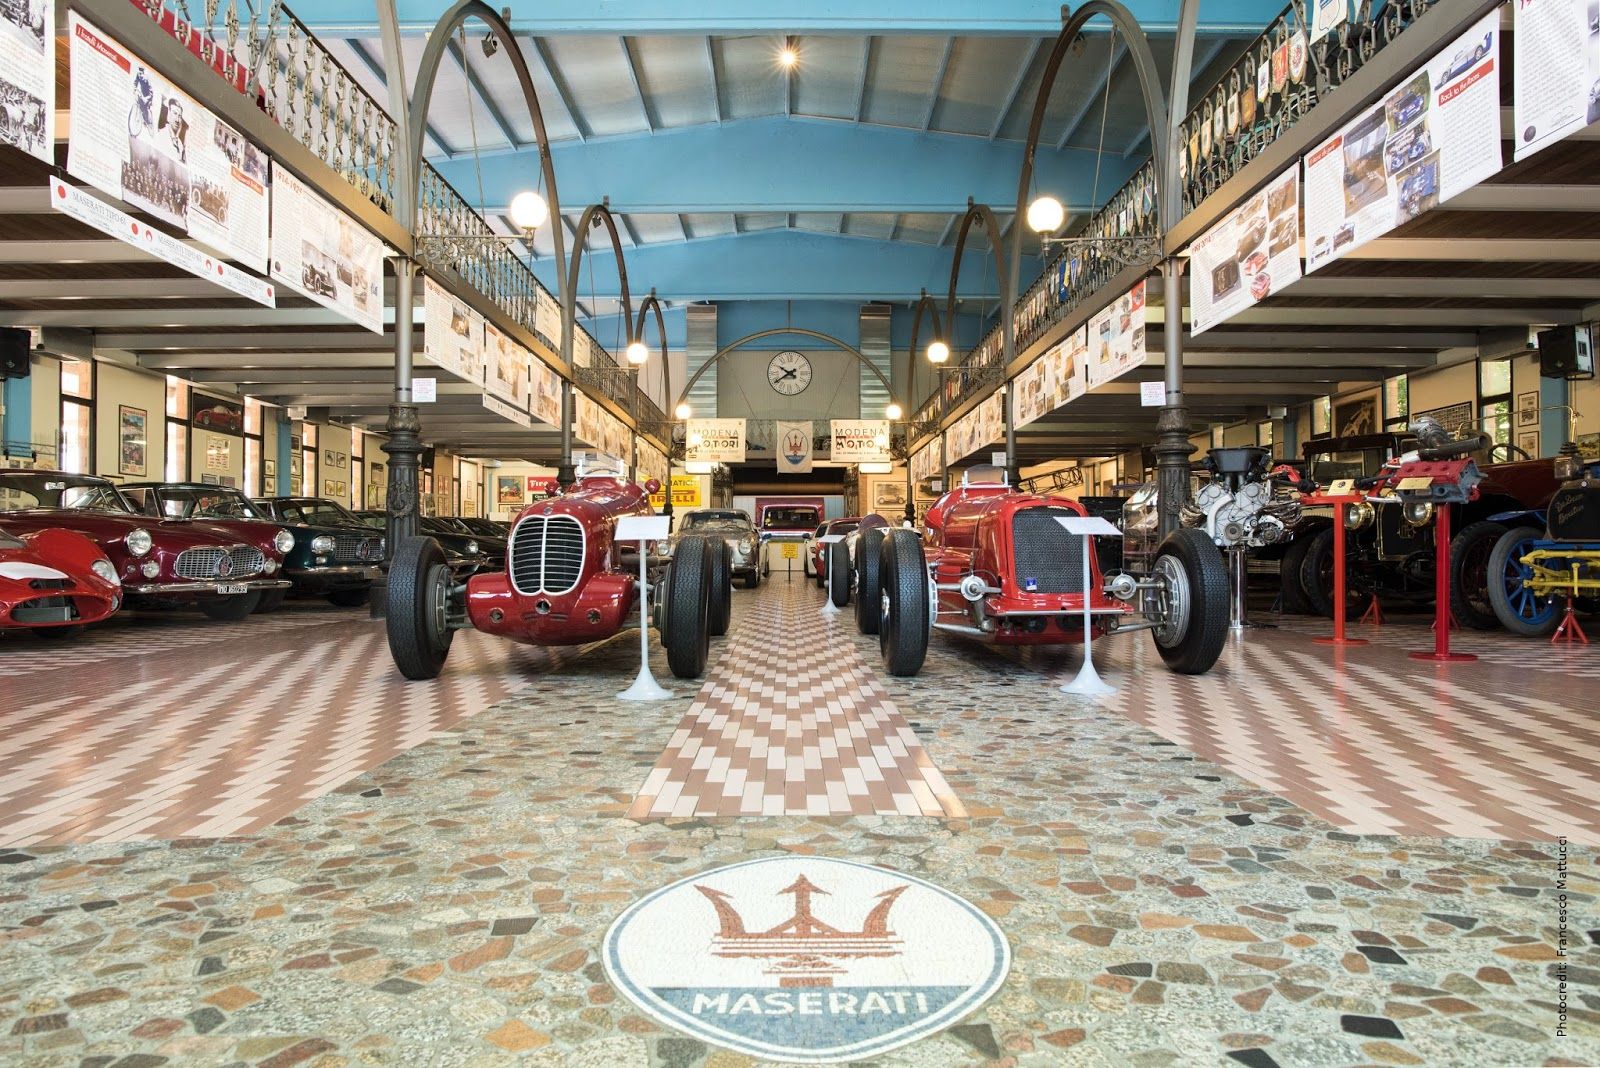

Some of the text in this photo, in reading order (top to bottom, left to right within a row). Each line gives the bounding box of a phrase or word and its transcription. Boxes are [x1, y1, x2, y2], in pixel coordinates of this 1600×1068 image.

[73, 191, 105, 215] MASERATI
[835, 428, 885, 436] MODENA
[694, 440, 739, 448] OTORI
[835, 439, 880, 448] MOTO
[651, 495, 695, 503] IRELLI
[692, 991, 929, 1015] MASERATI
